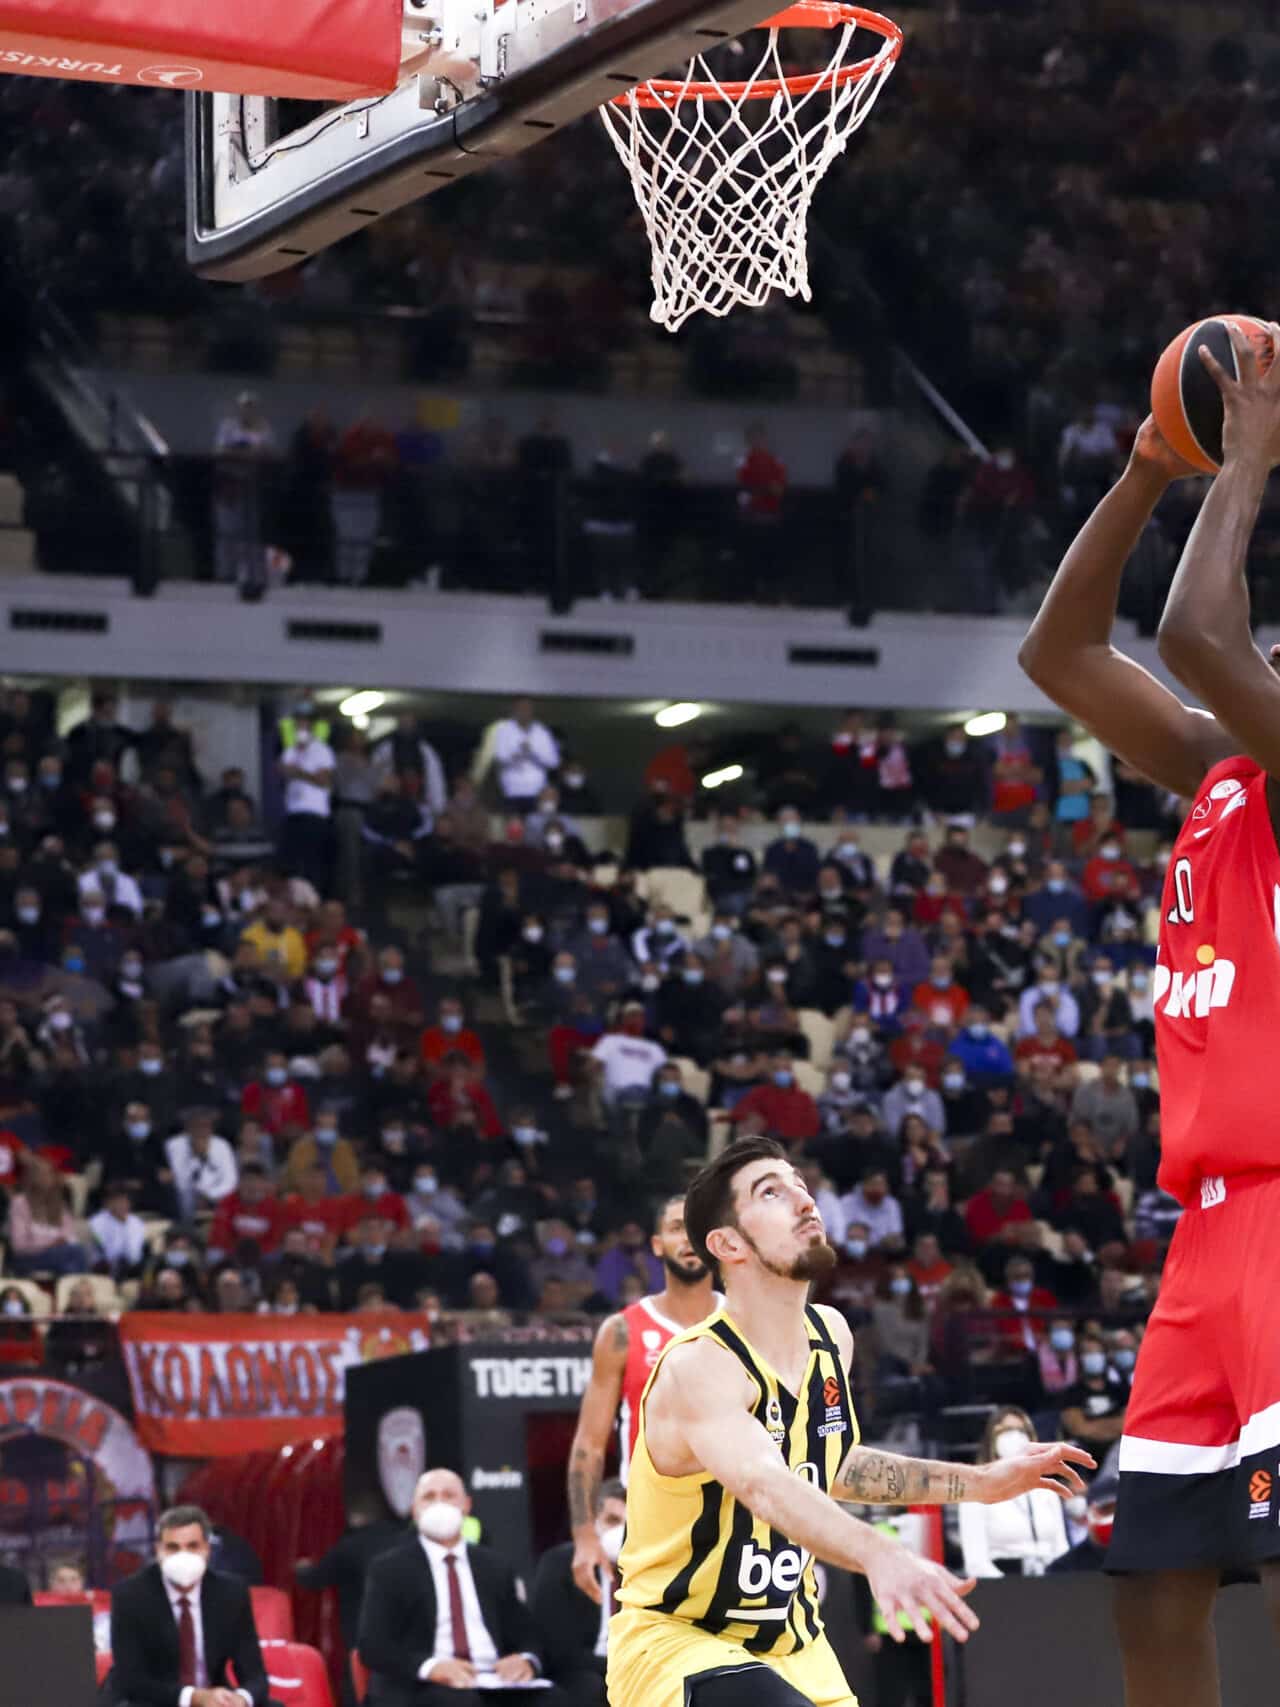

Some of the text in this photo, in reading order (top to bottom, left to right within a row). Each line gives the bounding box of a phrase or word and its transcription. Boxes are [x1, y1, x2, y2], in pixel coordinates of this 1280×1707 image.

[0, 50, 123, 76] TURKIS
[1167, 857, 1194, 925] 0
[738, 1544, 812, 1595] be
